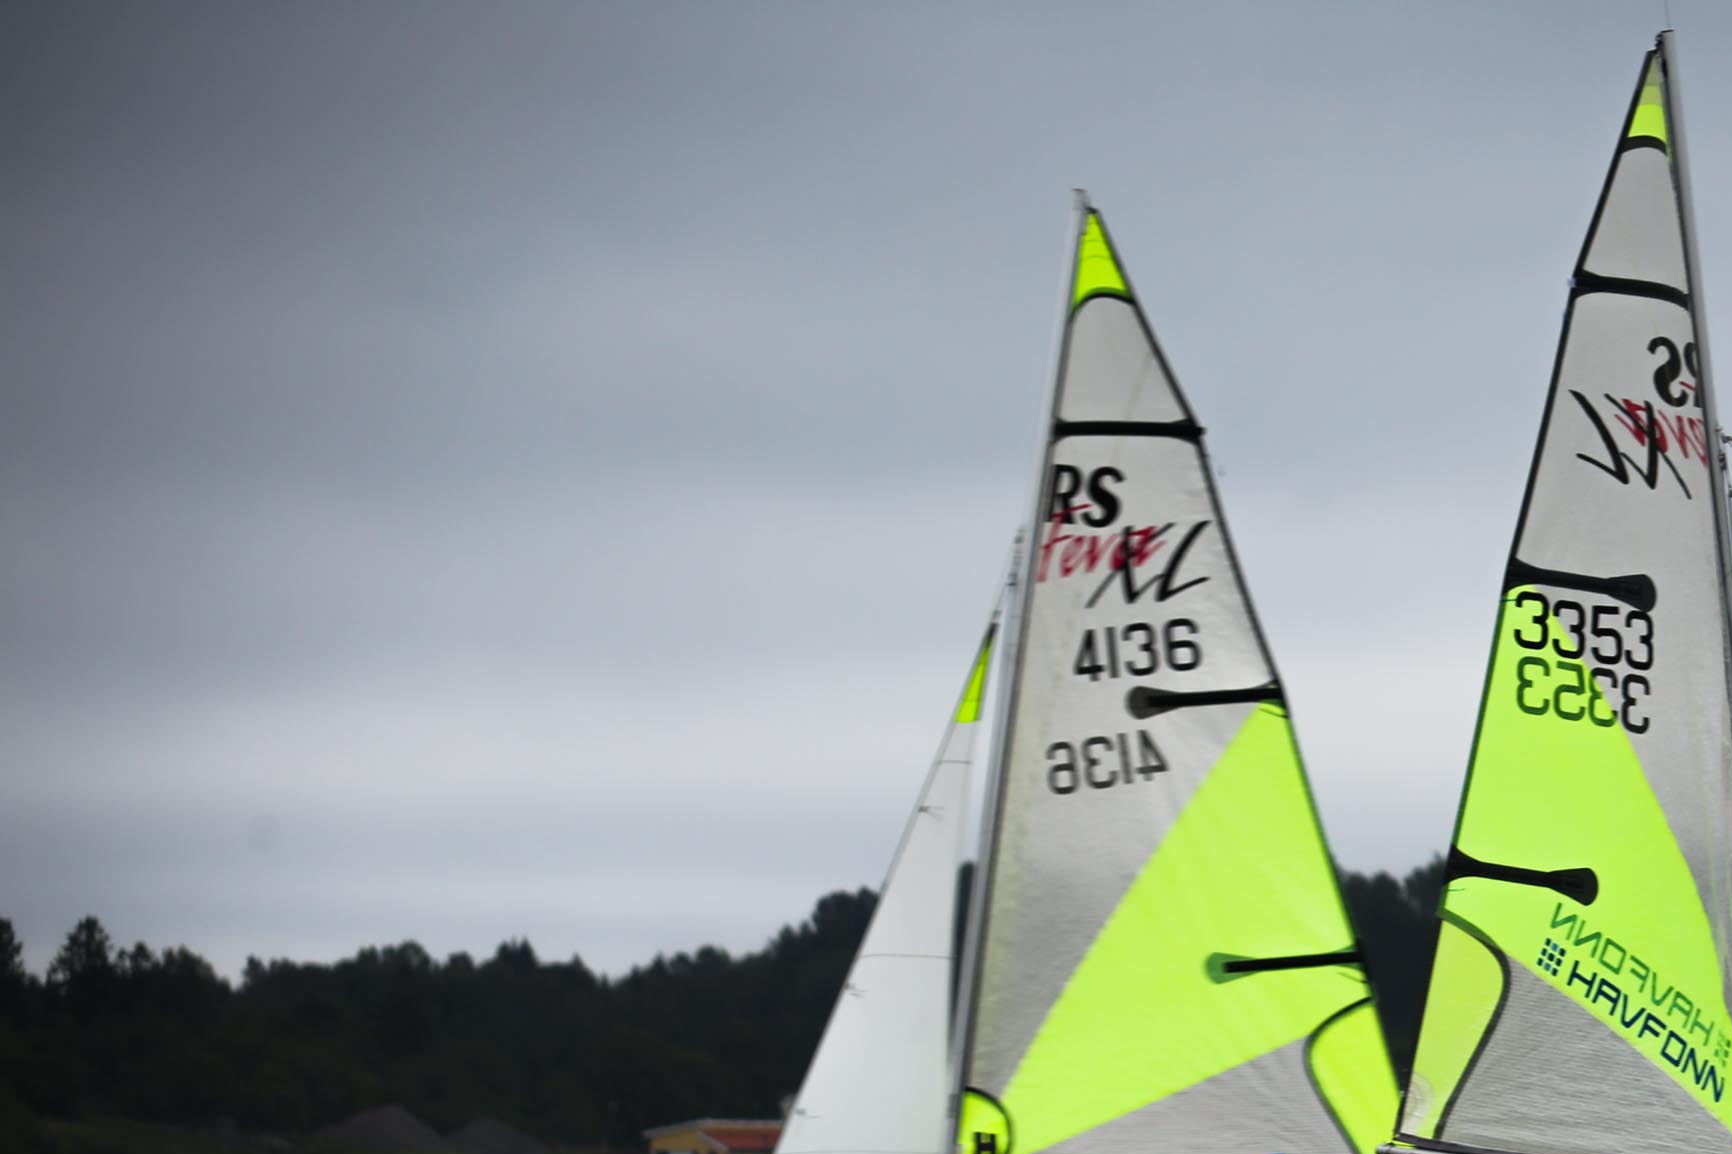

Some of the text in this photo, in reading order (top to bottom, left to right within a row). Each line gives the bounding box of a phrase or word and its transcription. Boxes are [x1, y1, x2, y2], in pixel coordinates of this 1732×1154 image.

[1046, 463, 1126, 528] RS
[1073, 618, 1202, 681] 4136
[1514, 591, 1654, 671] 3353
[1567, 960, 1725, 1103] HAVFONN
